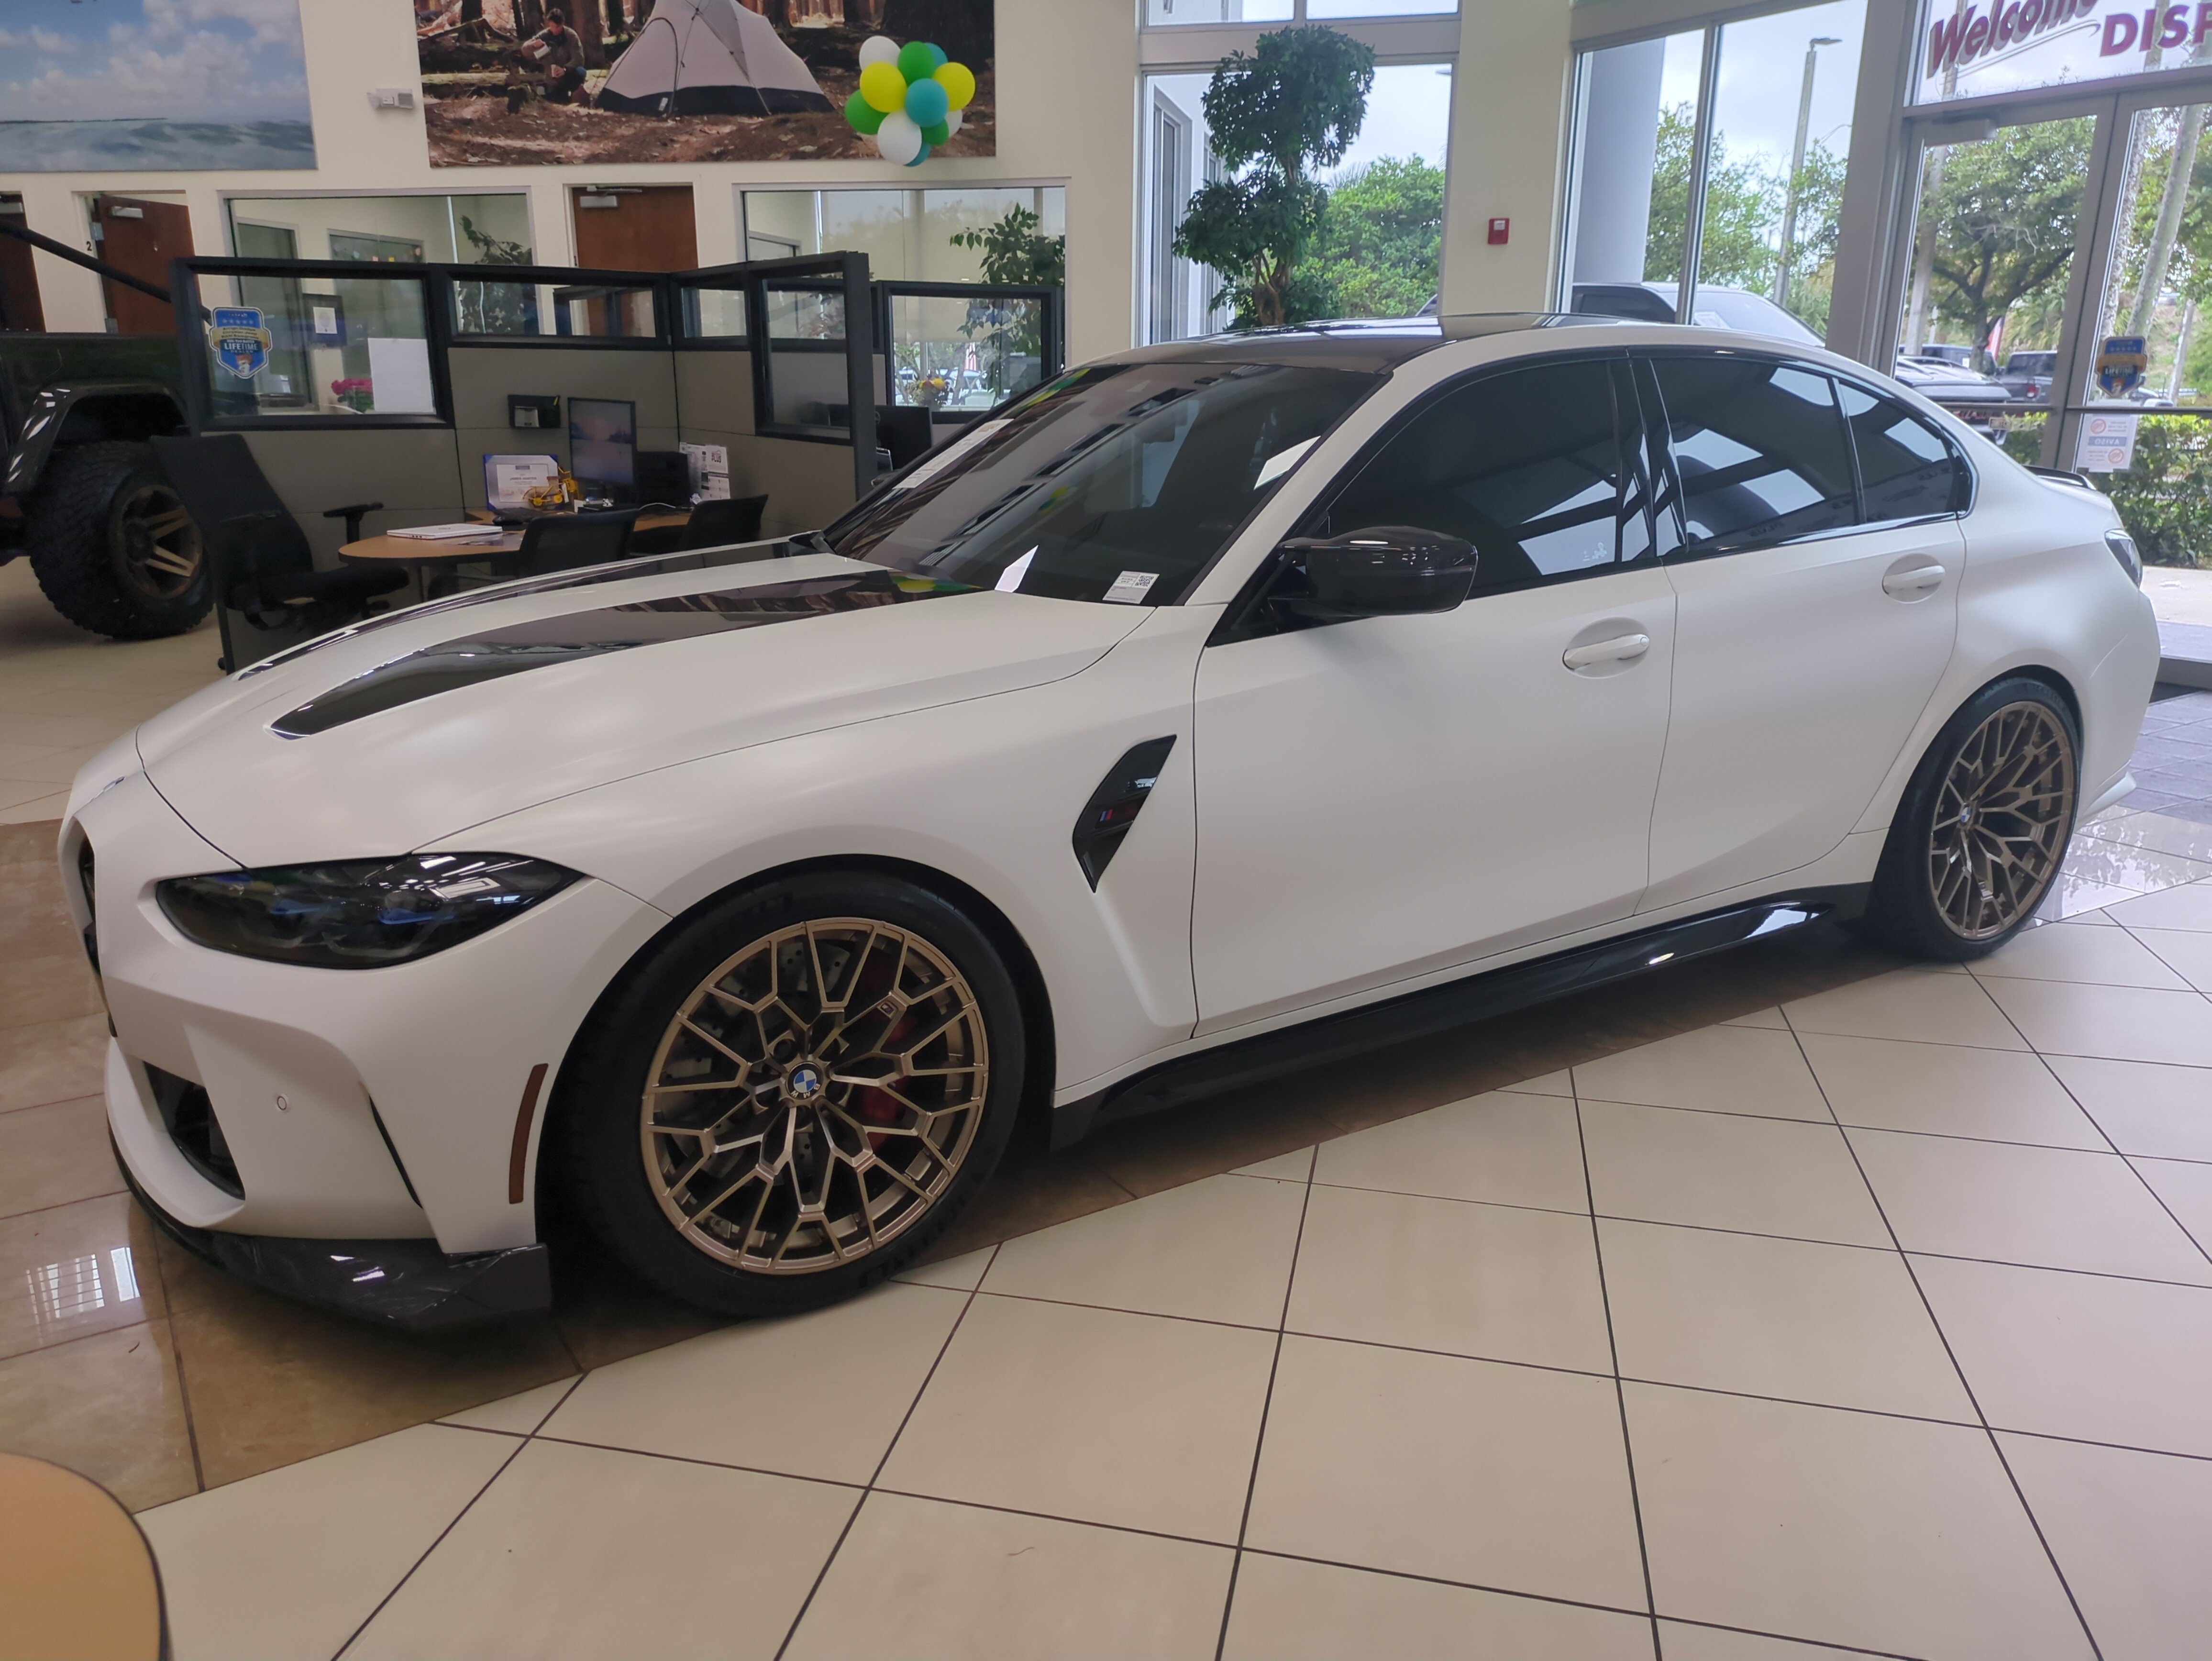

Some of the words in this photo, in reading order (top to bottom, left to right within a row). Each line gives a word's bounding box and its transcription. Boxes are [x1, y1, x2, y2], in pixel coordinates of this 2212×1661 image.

[86, 241, 92, 251] 2
[224, 343, 258, 351] LIFETIME
[791, 1084, 821, 1098] BMW
